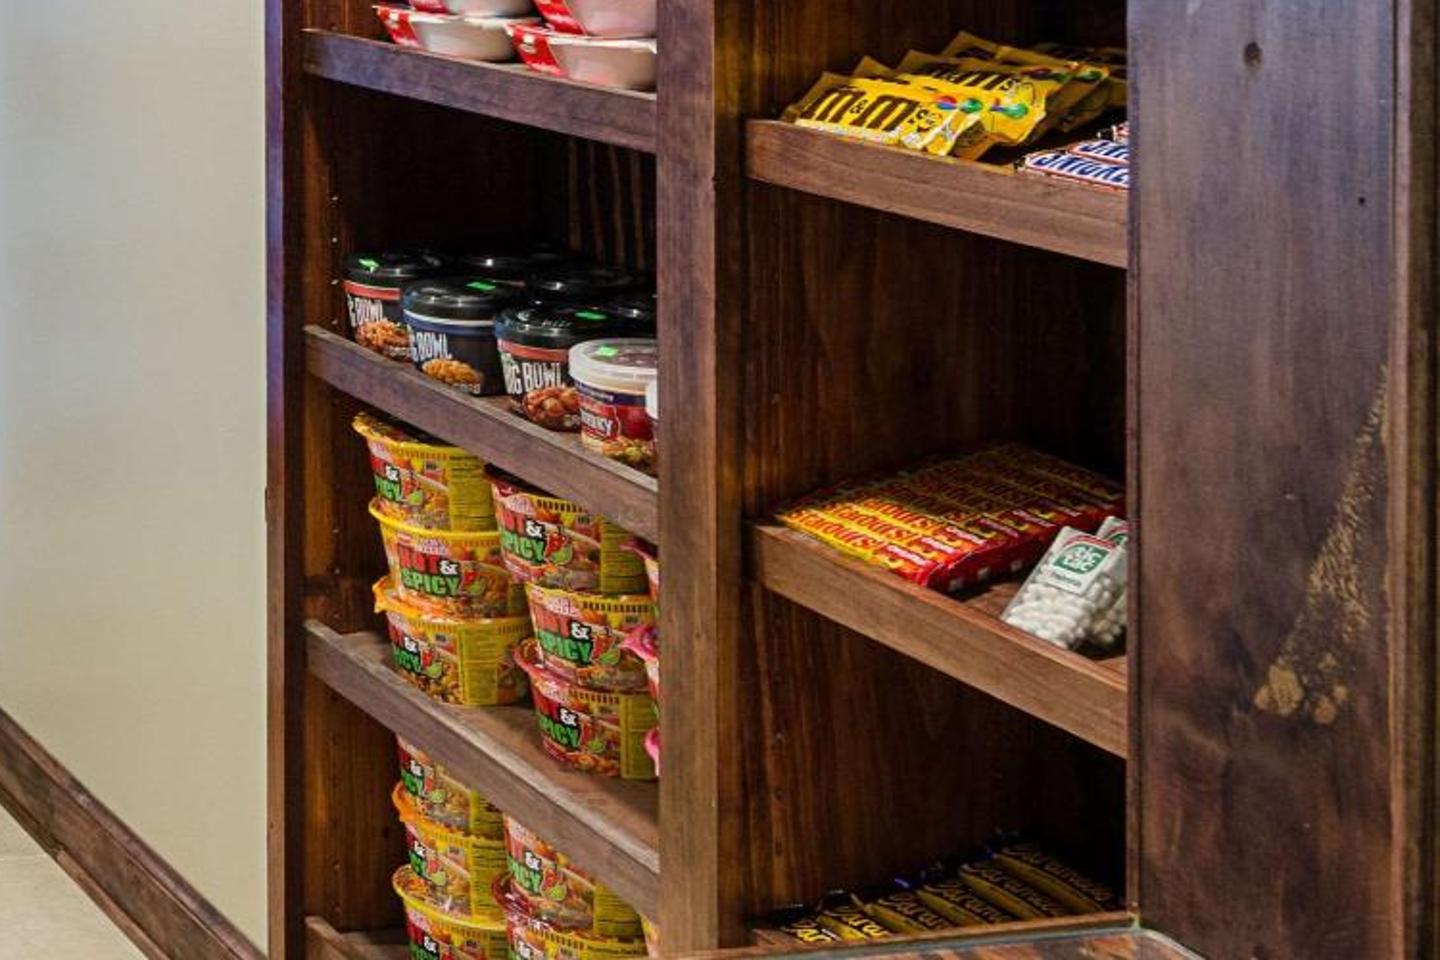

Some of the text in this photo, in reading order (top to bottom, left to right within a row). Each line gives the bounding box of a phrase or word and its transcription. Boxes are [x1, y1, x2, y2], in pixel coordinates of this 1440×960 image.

[525, 520, 545, 539] &
[439, 560, 458, 576] &
[400, 571, 460, 597] SPICY
[570, 621, 591, 640] &
[559, 707, 578, 726] &
